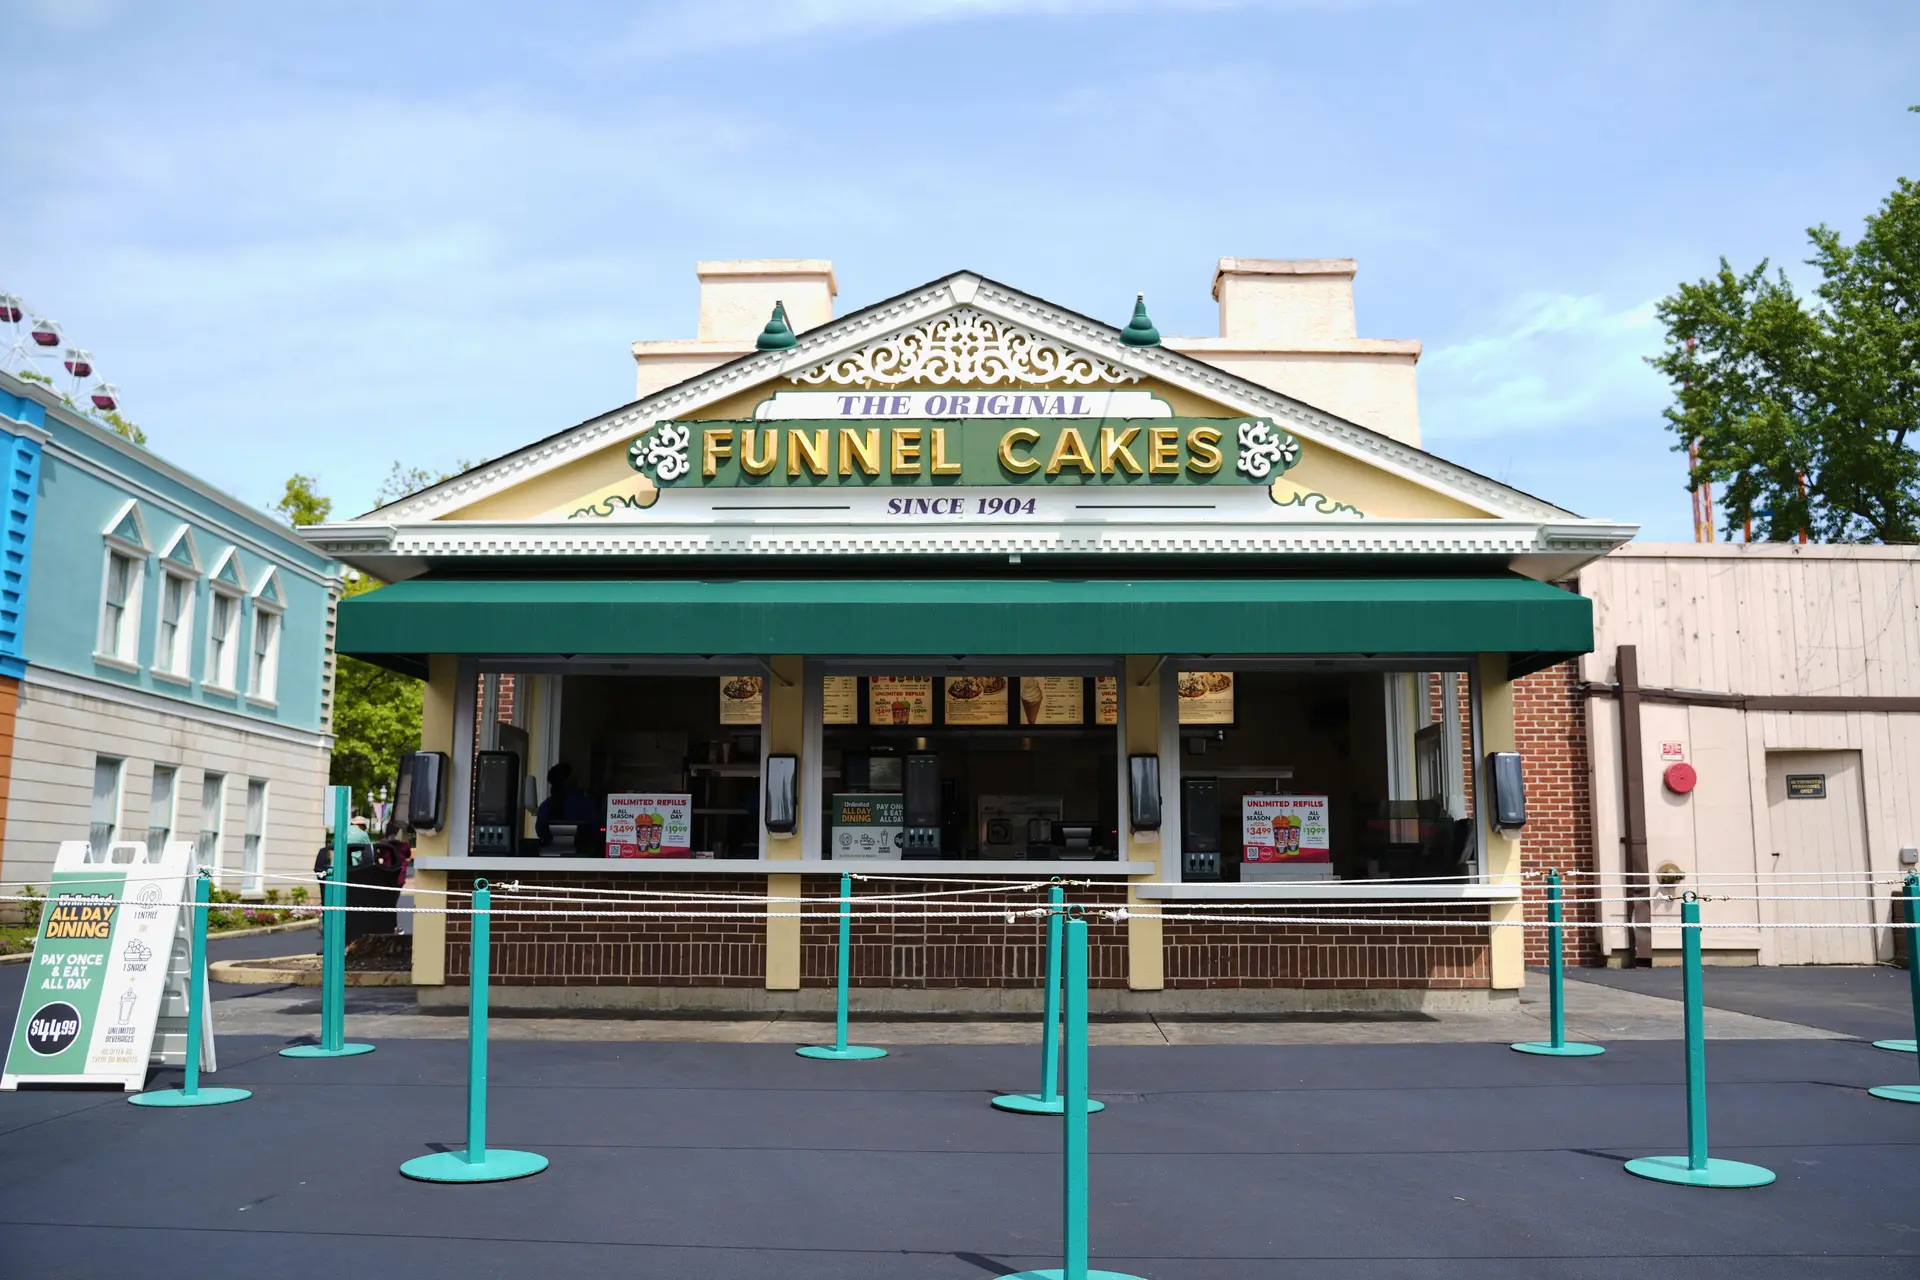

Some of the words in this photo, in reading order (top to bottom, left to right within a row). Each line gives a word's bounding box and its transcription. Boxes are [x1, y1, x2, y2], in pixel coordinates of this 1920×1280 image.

[837, 395, 911, 415] THE
[924, 395, 1091, 415] ORIGINAL
[702, 427, 962, 477] FUNNEL
[998, 426, 1224, 475] CAKES
[886, 497, 965, 515] SINCE
[976, 497, 1036, 515] 1904
[842, 815, 872, 823] DINING
[50, 907, 81, 921] ALL
[82, 907, 115, 921] DAY
[46, 922, 110, 938] DINING
[40, 954, 66, 966] PAY
[67, 954, 104, 966] ONCE
[51, 966, 60, 977] &
[63, 966, 88, 977] EAT
[127, 963, 148, 972] SNACK
[41, 978, 65, 990] ALL
[67, 978, 91, 990] DAY
[107, 1027, 136, 1035] UNLIMITED
[105, 1034, 135, 1043] BEVERAGES
